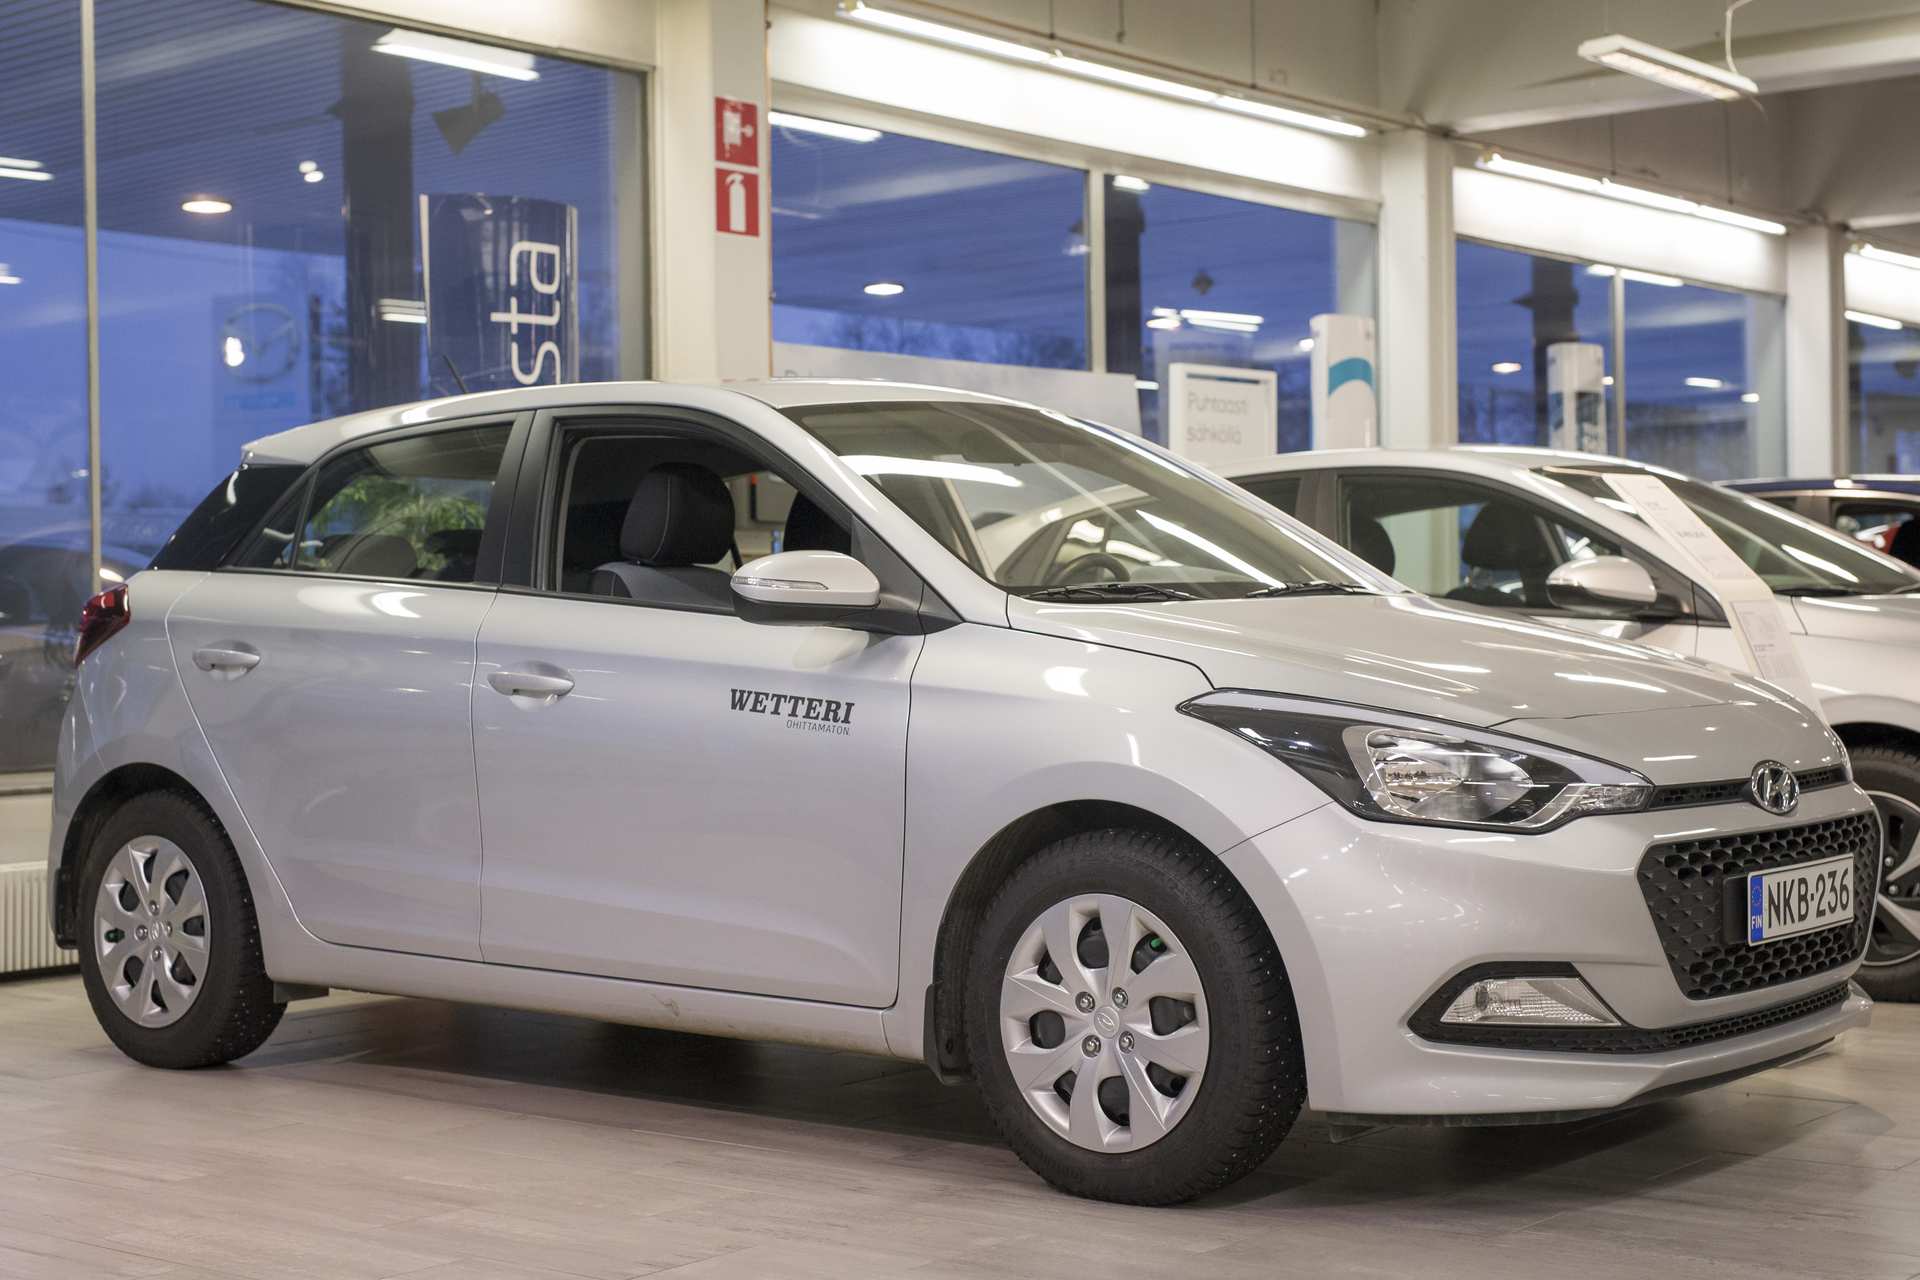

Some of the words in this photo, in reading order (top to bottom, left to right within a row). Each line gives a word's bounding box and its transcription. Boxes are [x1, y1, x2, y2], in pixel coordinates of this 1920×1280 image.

[730, 688, 855, 724] WETTERI
[1767, 867, 1850, 929] NKB-236
[1751, 915, 1763, 930] FIN
